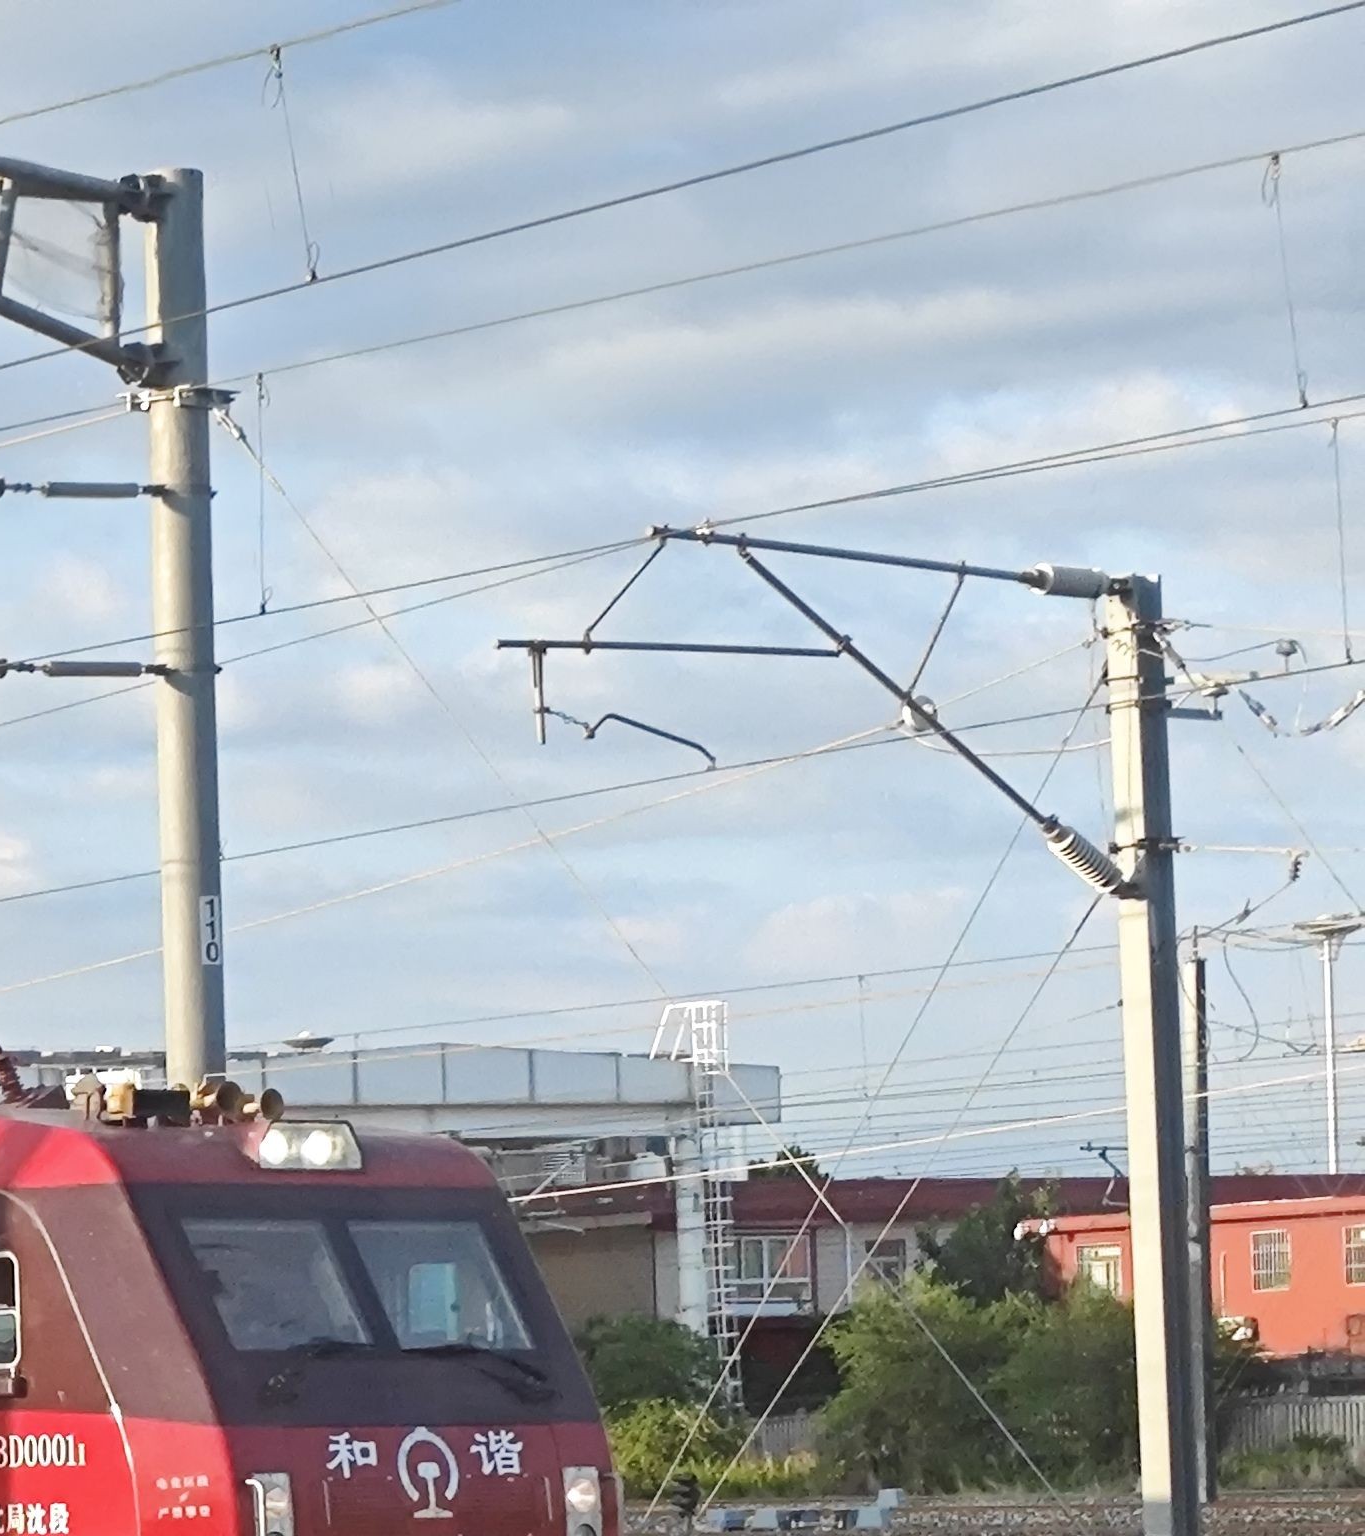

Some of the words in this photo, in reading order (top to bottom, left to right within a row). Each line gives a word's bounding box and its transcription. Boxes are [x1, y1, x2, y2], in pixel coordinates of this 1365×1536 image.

[204, 898, 219, 963] 110
[326, 1431, 378, 1479] 和
[470, 1429, 523, 1476] 谐
